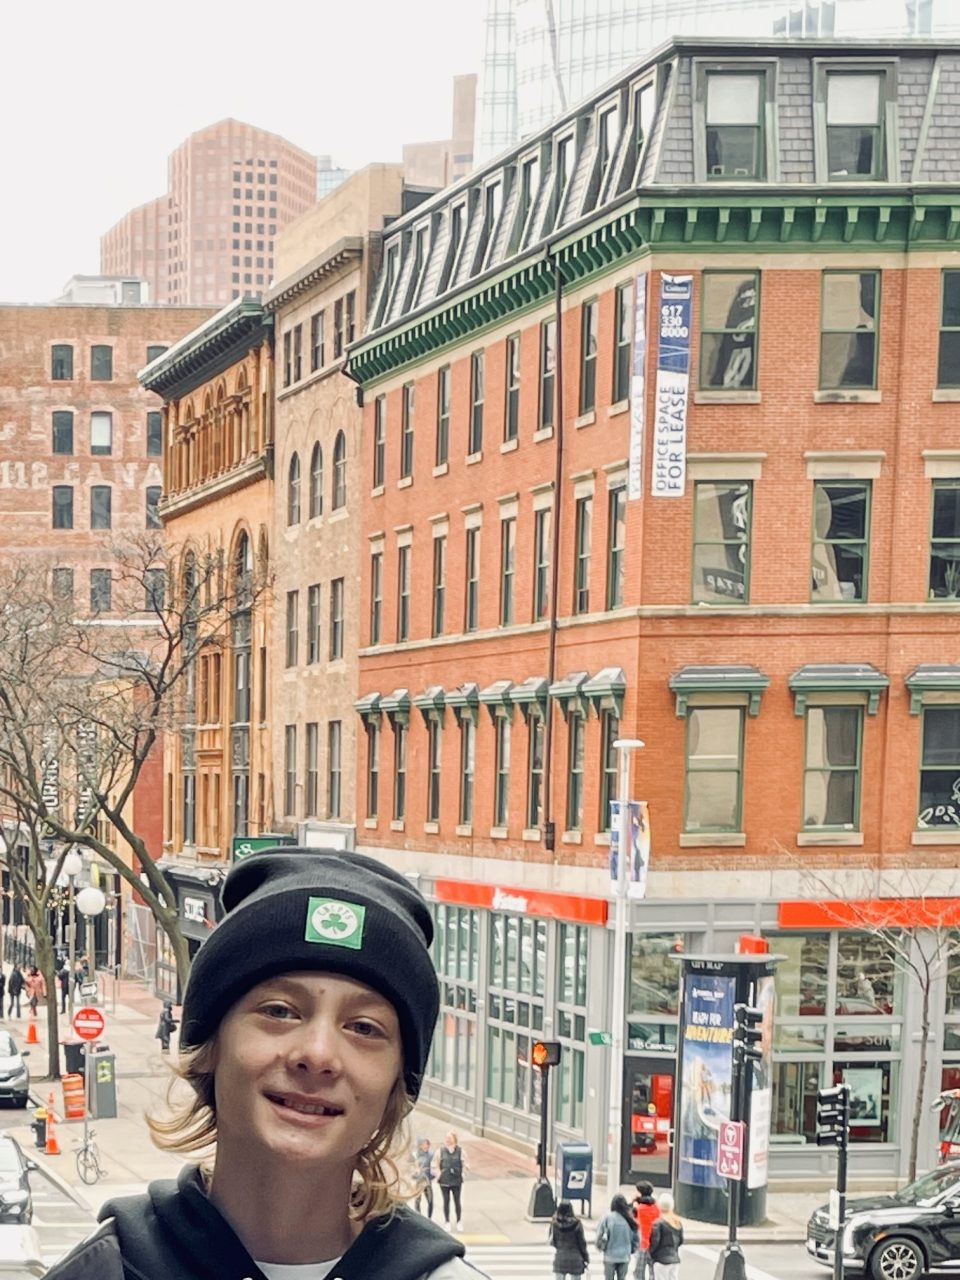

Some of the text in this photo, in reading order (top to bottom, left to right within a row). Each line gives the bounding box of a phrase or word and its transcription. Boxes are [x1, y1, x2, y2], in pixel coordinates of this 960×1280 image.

[661, 305, 683, 316] 617
[661, 316, 683, 327] 330
[660, 326, 689, 338] 8000
[655, 387, 671, 491] OFFICE SPACE
[667, 387, 686, 490] FOR LEASE
